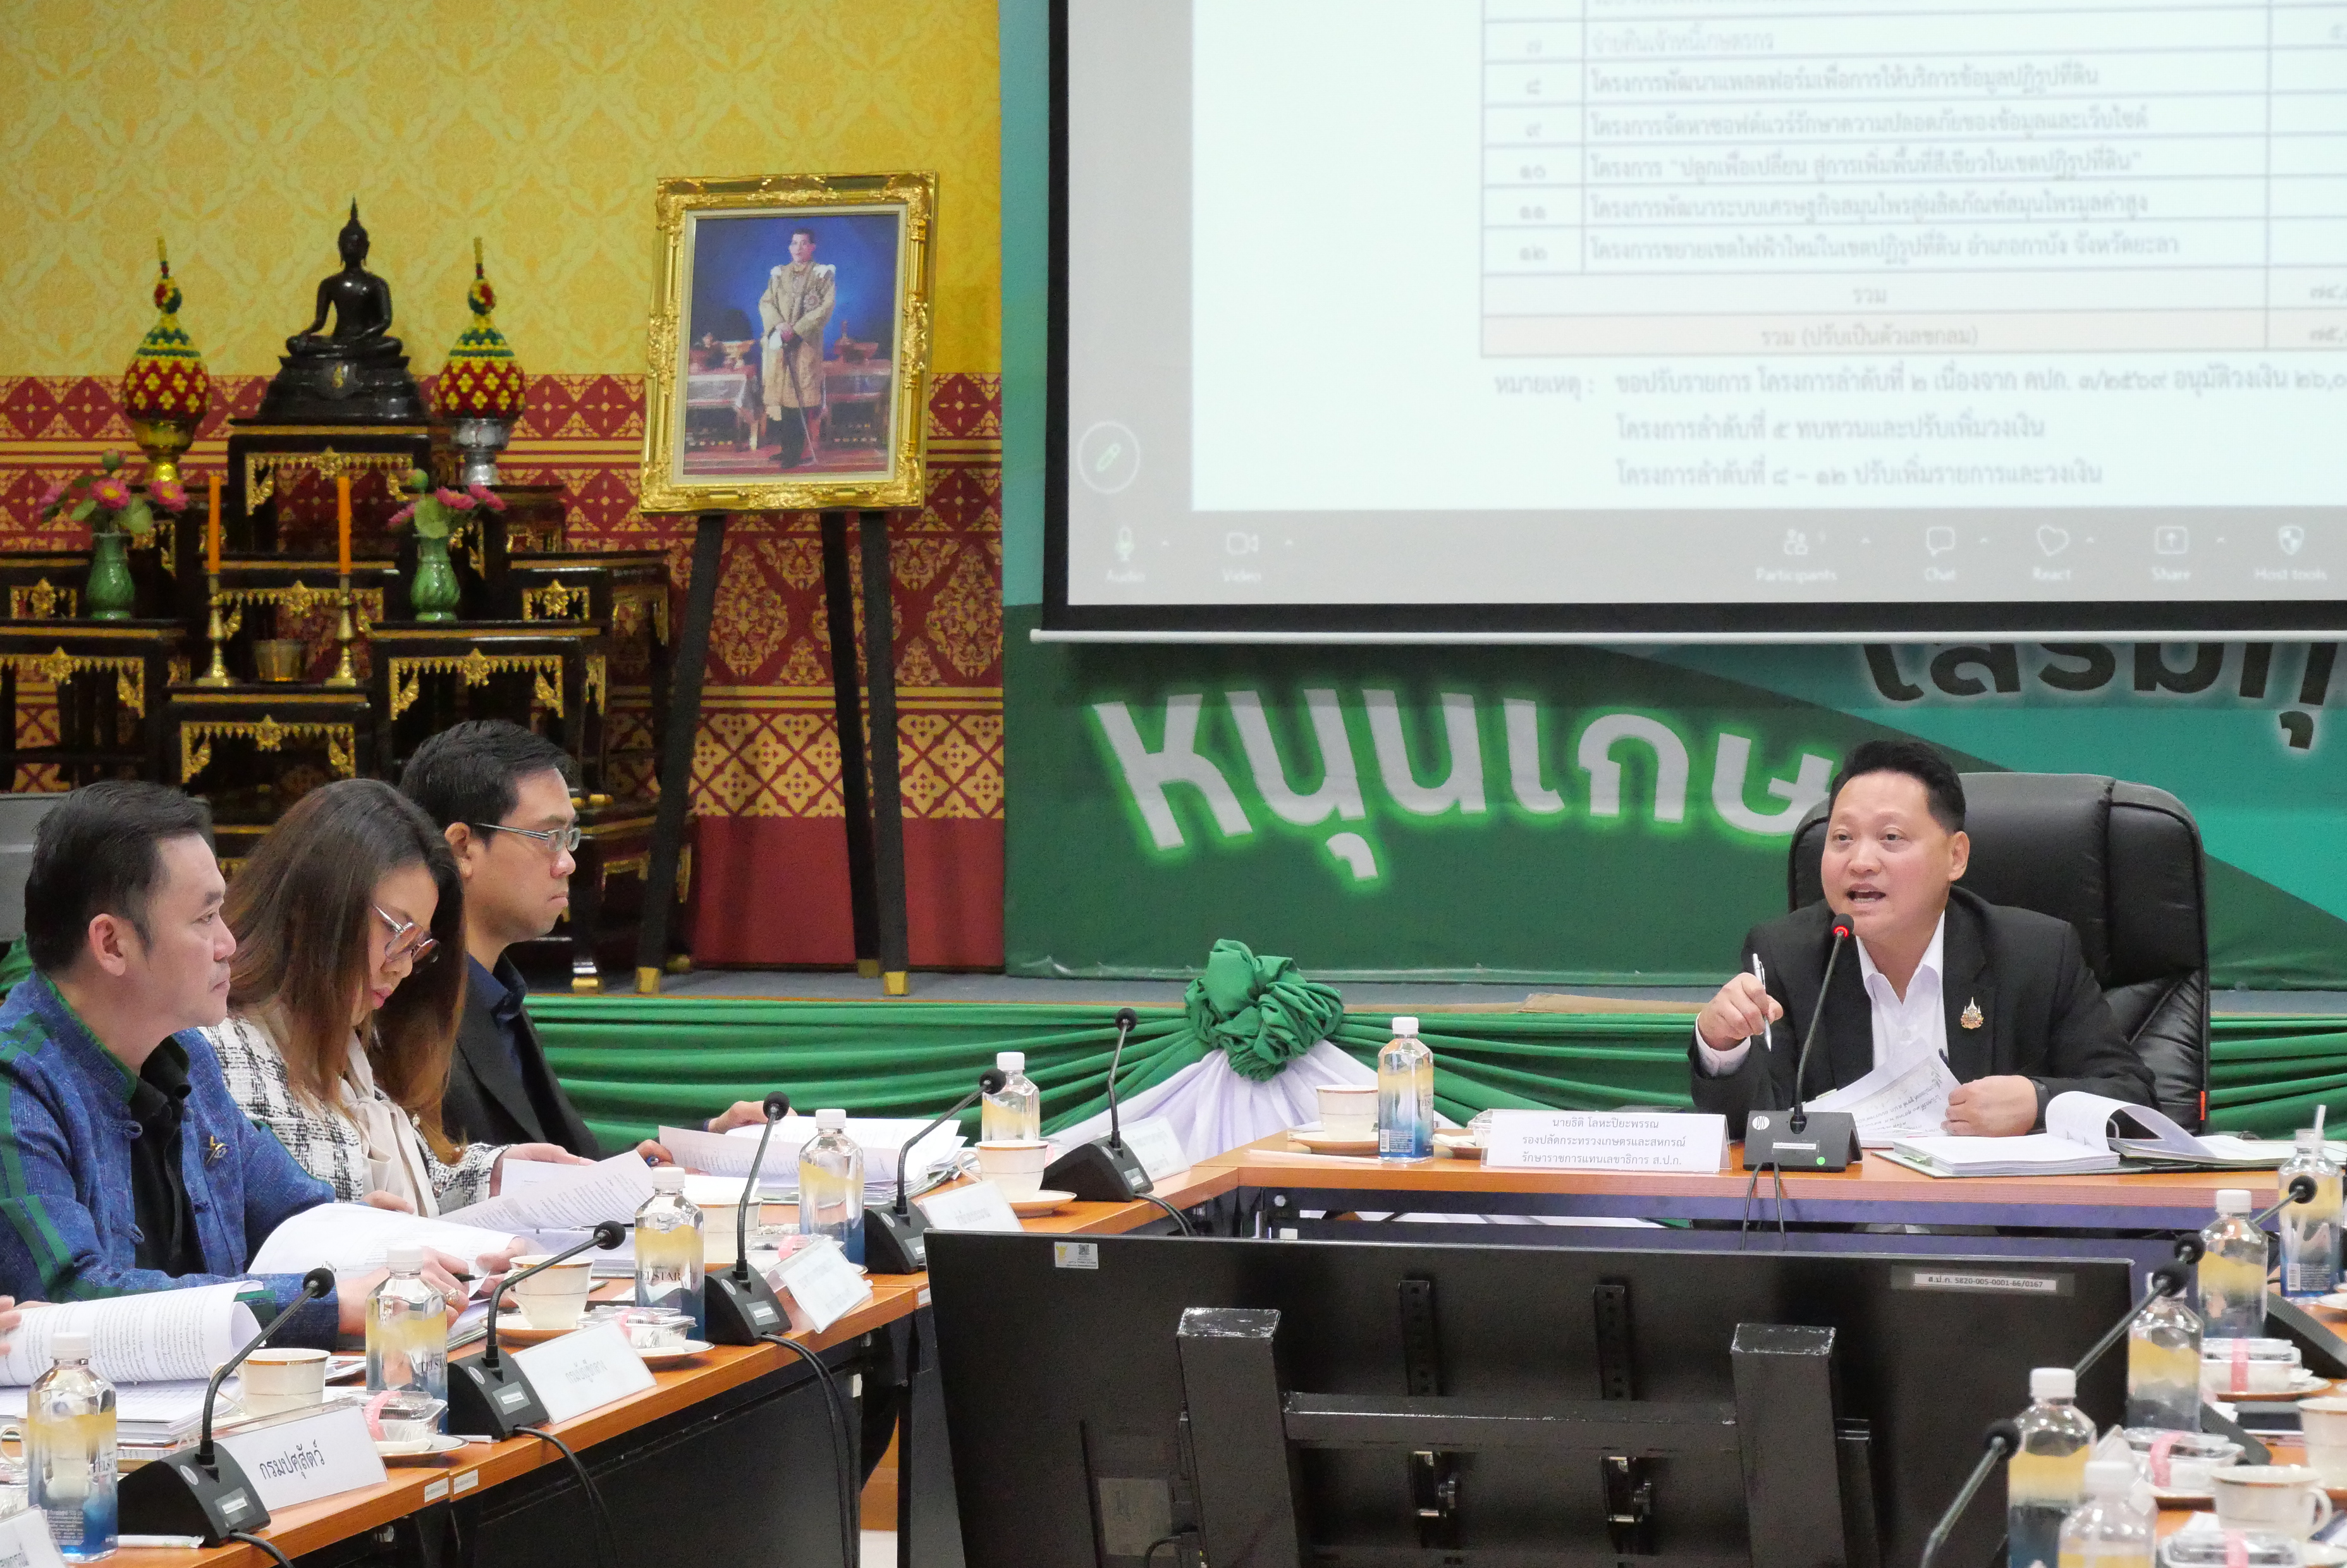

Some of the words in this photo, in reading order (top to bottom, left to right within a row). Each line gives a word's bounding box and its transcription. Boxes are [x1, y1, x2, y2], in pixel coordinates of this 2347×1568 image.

[1591, 154, 1662, 178] โครงการ
[1853, 283, 1887, 304] รวม
[1762, 328, 1796, 346] รวม
[1615, 367, 1751, 393] ขอปรับรายการ
[1933, 358, 2018, 392] เนื่องจาก
[2151, 566, 2191, 581] Share
[1552, 1116, 1584, 1128] นายธิติ
[1588, 1116, 1659, 1129] โลหะปิยะพรรณ
[1523, 1134, 1686, 1148] รองปลัดกระทรวงเกษตรและสหกรณ์
[1522, 1151, 1649, 1165] รักษาราชการแทนเลขาธิการ
[1652, 1155, 1682, 1166] ส.ป.ก.
[259, 1439, 325, 1479] กรมปศุสัตว์
